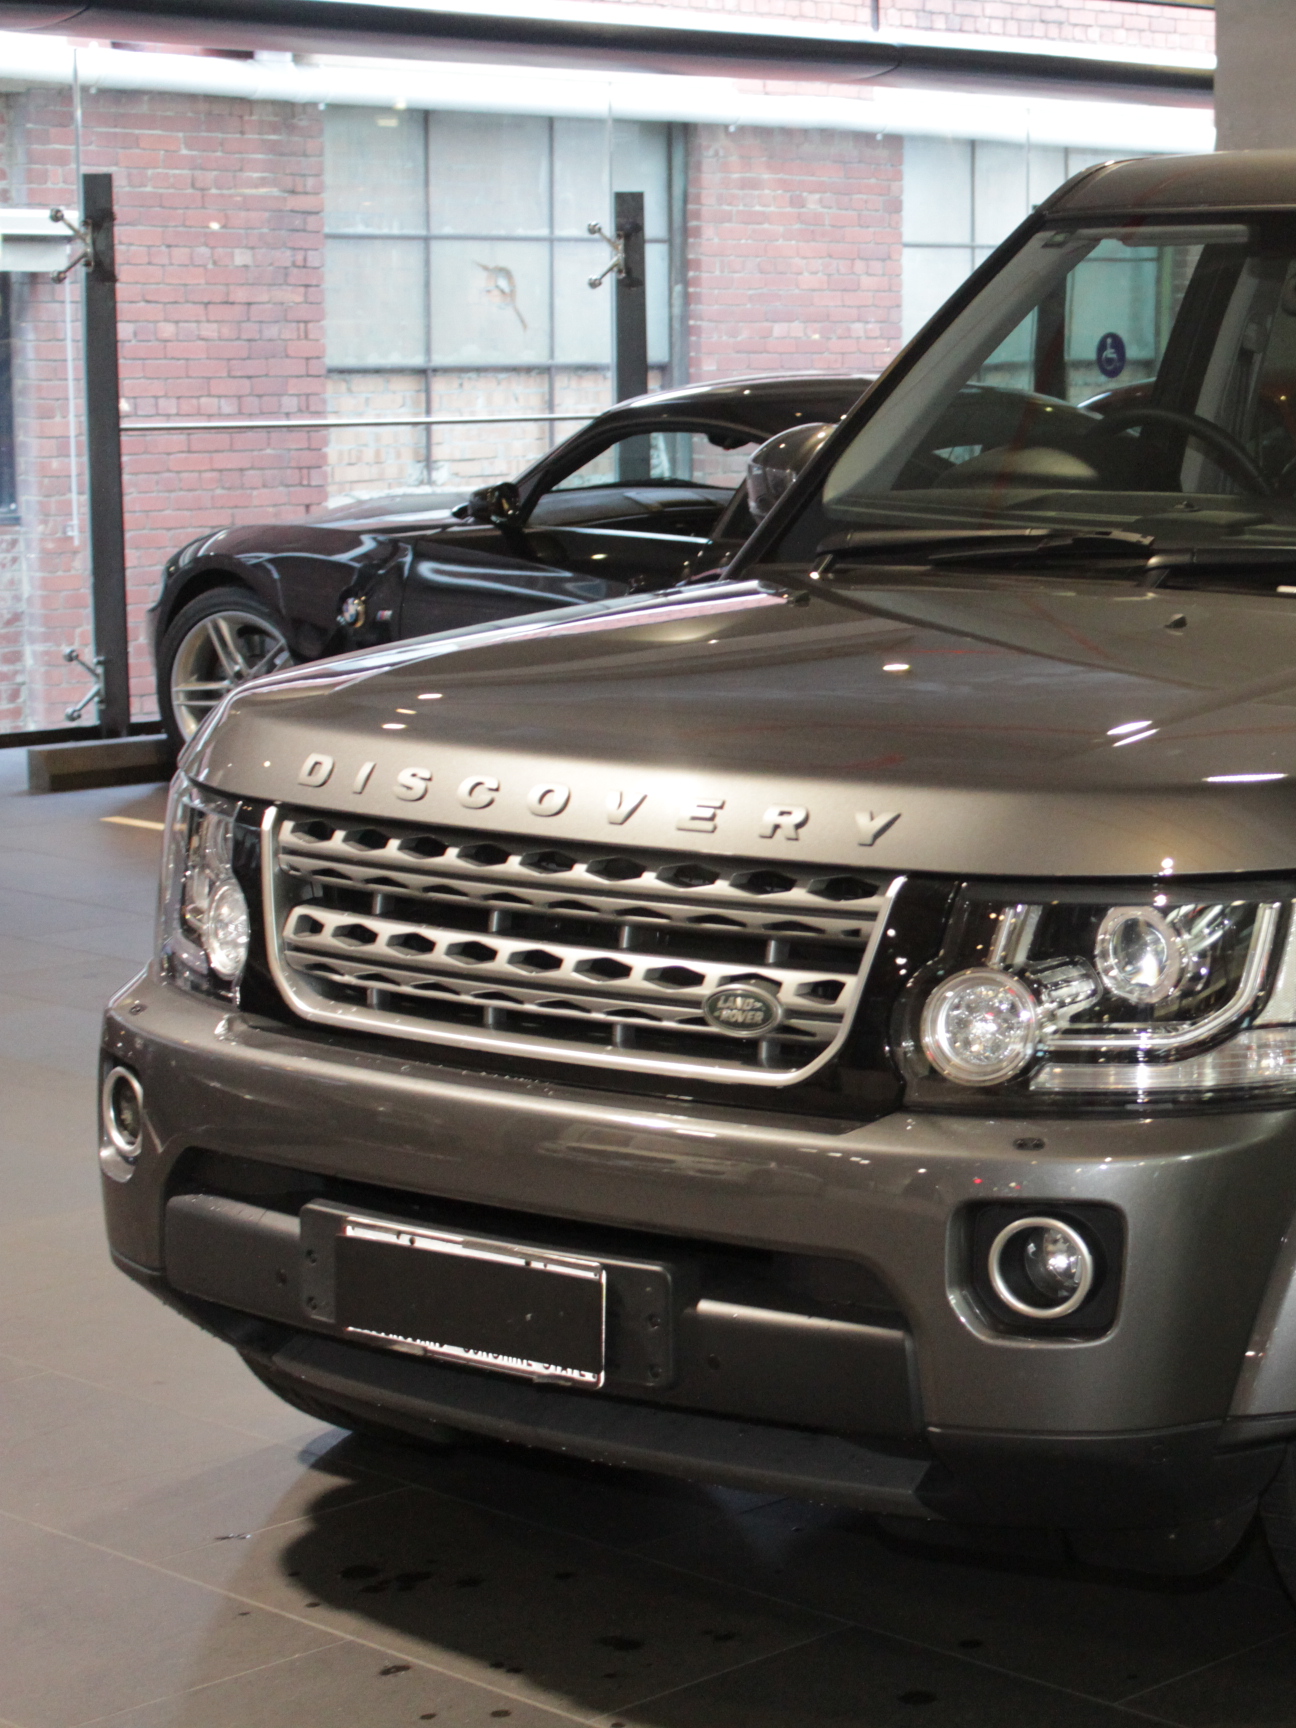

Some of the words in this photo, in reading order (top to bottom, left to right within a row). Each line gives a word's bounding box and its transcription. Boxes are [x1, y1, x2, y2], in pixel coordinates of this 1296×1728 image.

[298, 752, 901, 847] DISCOVERY
[717, 995, 755, 1010] LAND
[720, 1009, 764, 1024] ROVER
